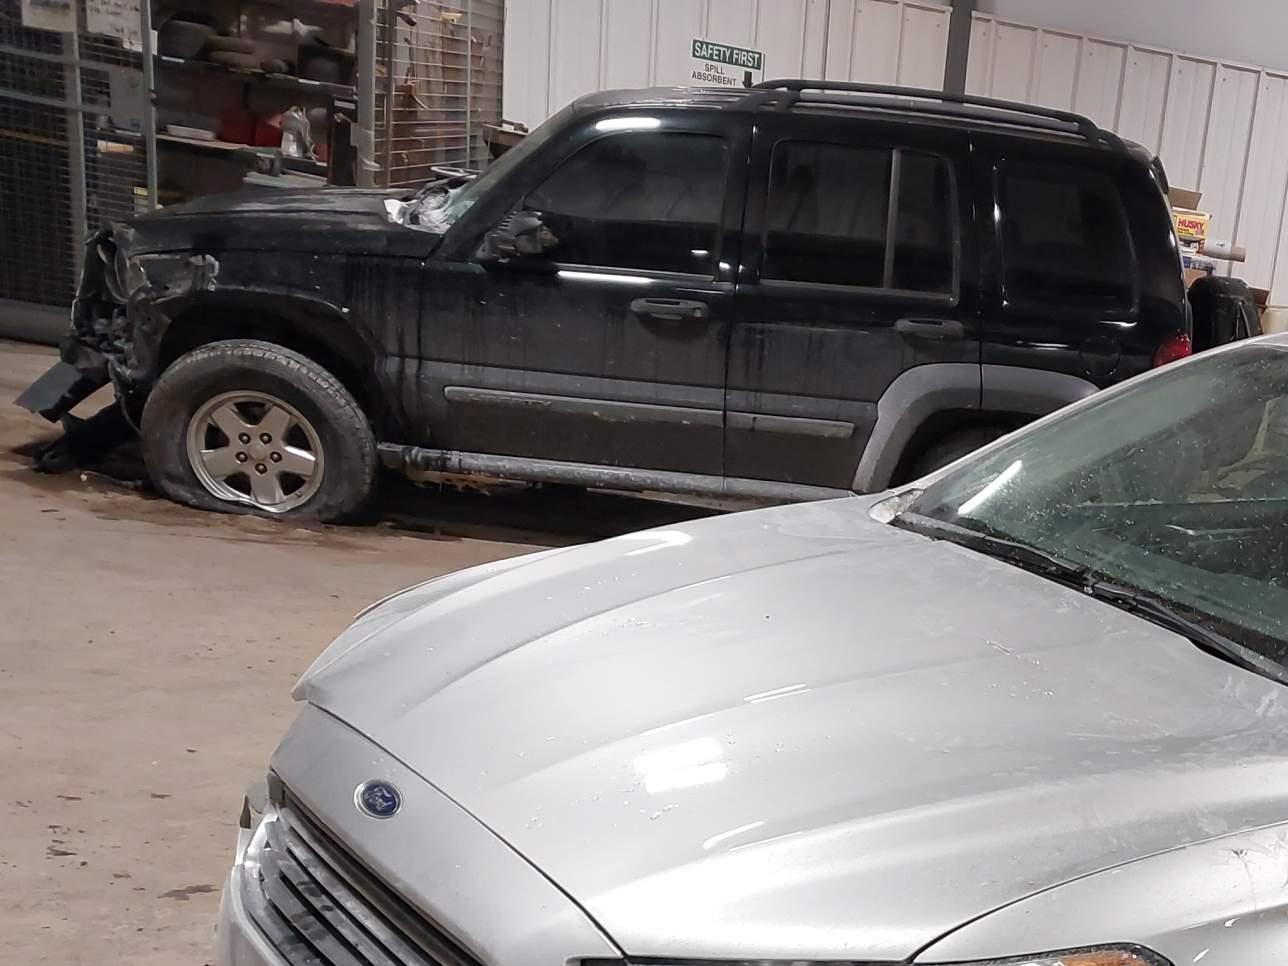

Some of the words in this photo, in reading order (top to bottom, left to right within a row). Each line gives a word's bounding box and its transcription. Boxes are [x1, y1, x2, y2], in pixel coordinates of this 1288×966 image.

[694, 42, 732, 62] SAFETY
[732, 49, 760, 68] FIRST
[704, 63, 725, 75] SPILL
[691, 70, 737, 87] ABSORBENT
[1178, 218, 1205, 231] HUSKY
